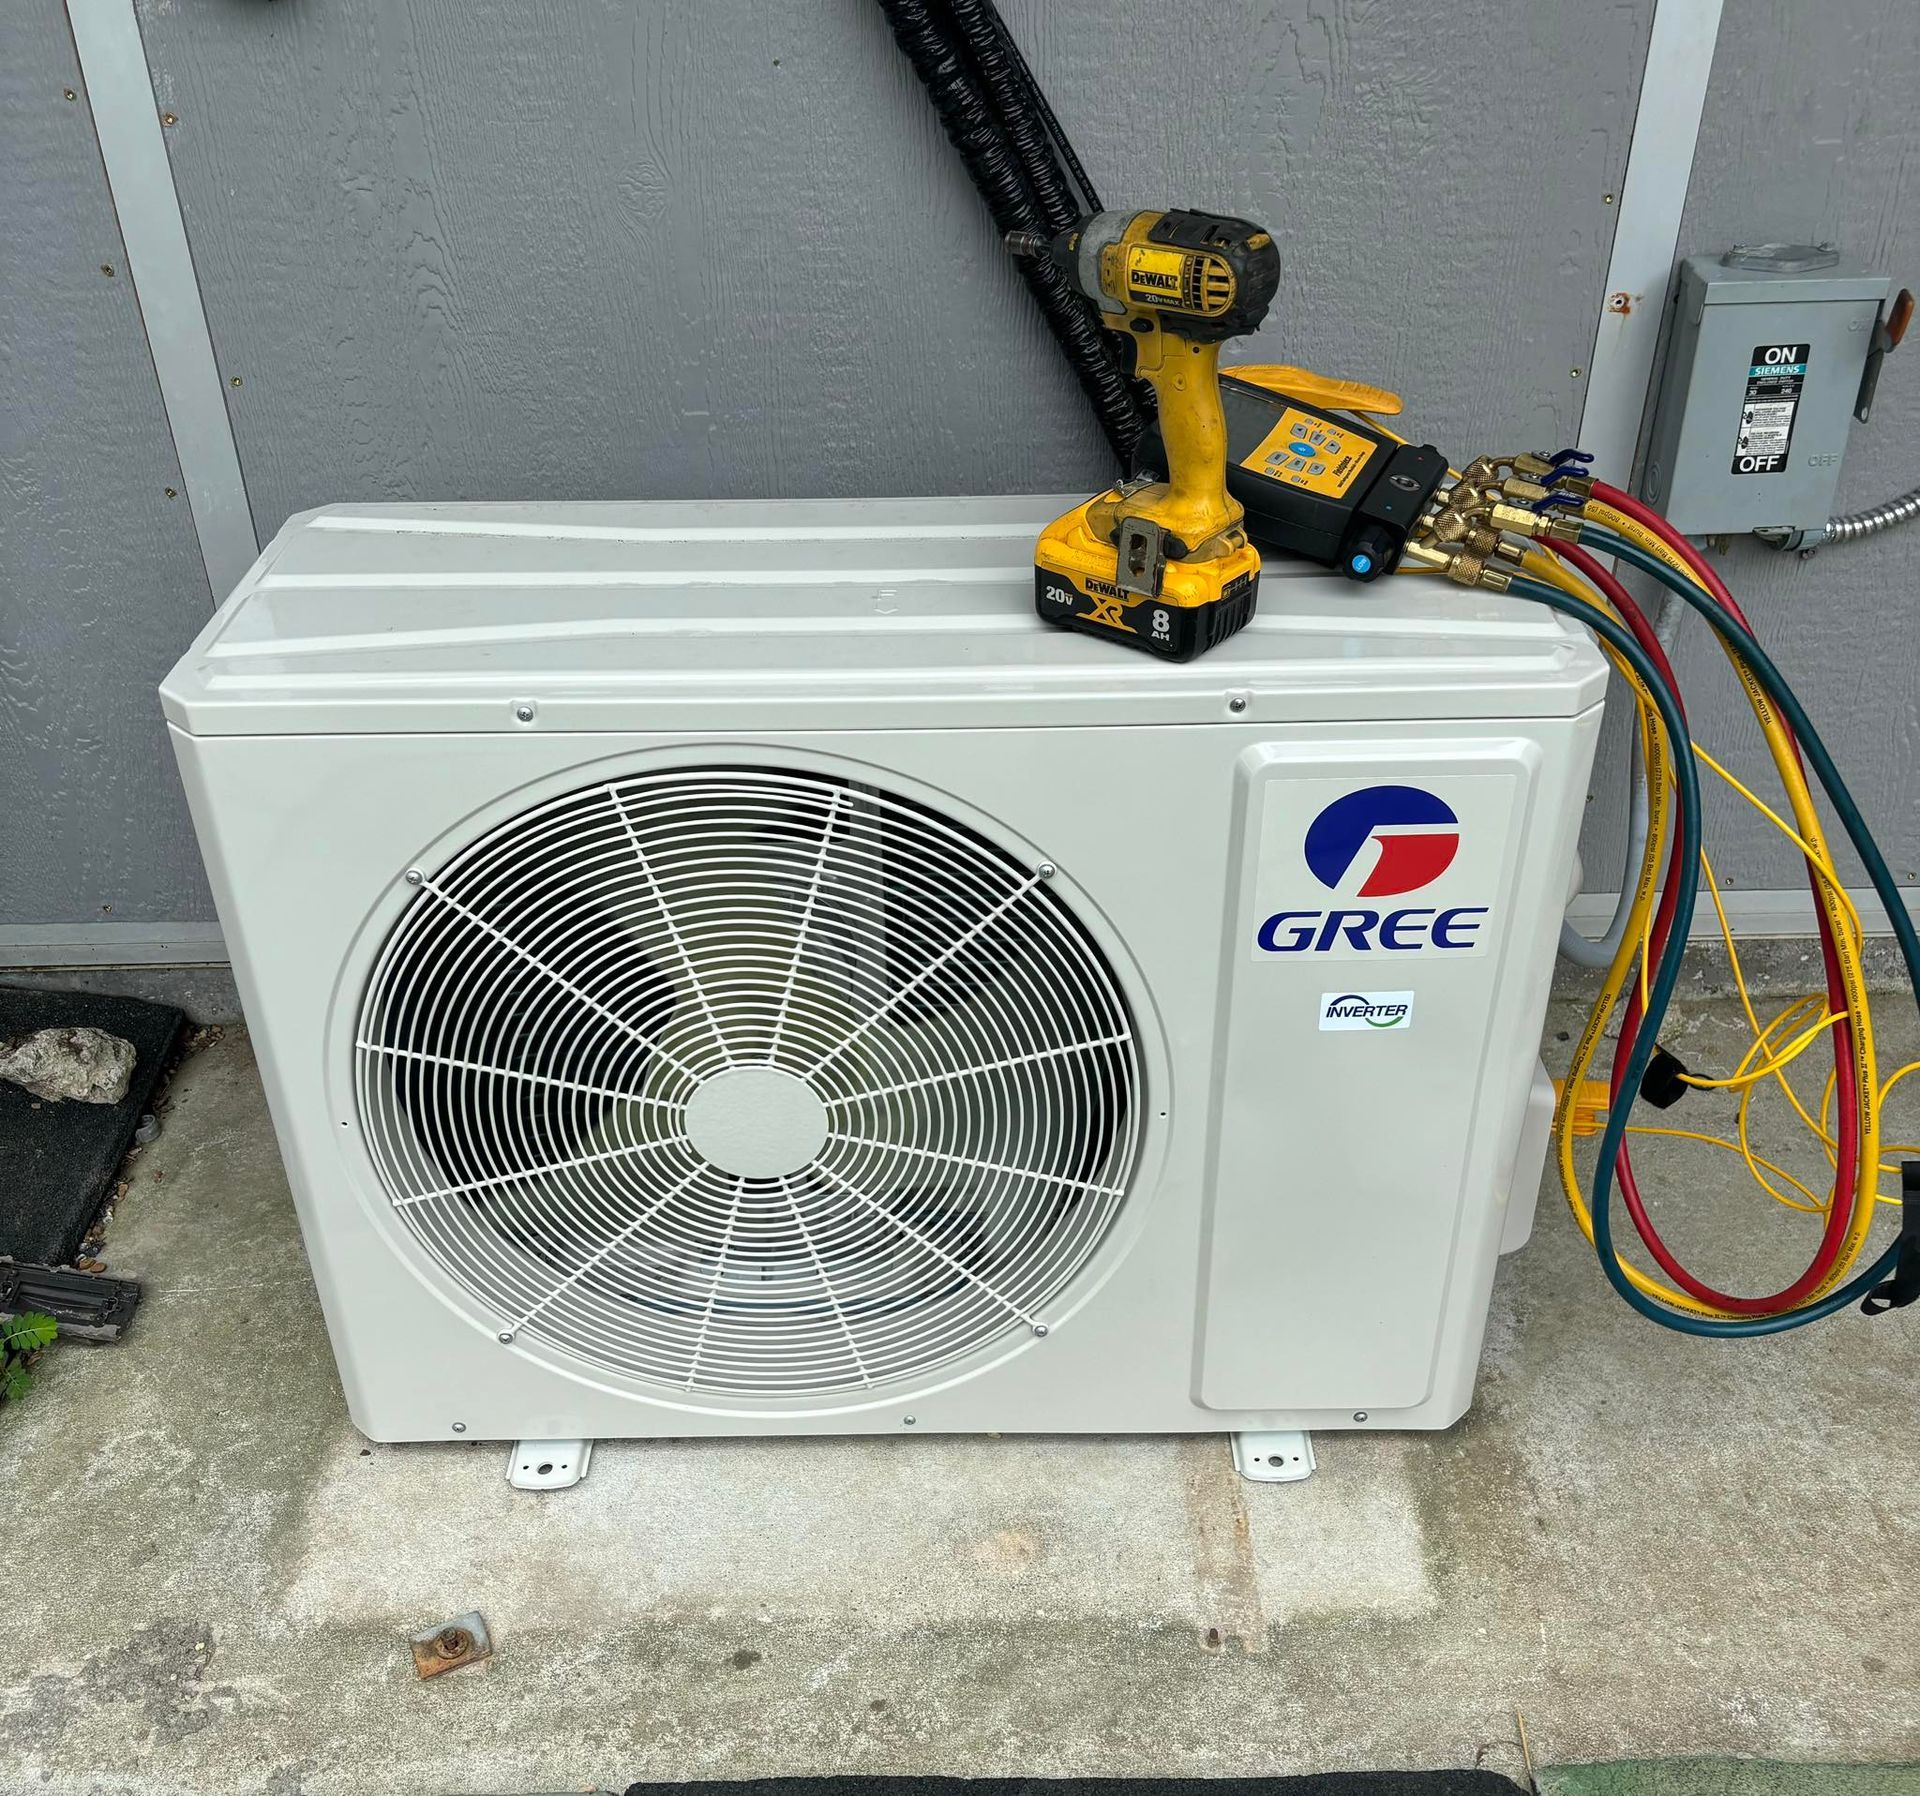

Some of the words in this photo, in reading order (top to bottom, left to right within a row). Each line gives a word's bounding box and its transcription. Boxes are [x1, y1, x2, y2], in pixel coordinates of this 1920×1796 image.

[1765, 347, 1797, 364] ON
[1754, 365, 1799, 376] SIEMENS
[1740, 455, 1780, 472] OFF
[1152, 609, 1170, 632] 8
[1755, 697, 1772, 725] YELLOW
[1257, 906, 1489, 952] GREE
[1833, 919, 1844, 936] burst
[1326, 1004, 1408, 1018] INVERTER
[1853, 1010, 1862, 1026] Hose
[1856, 1027, 1867, 1054] Charging
